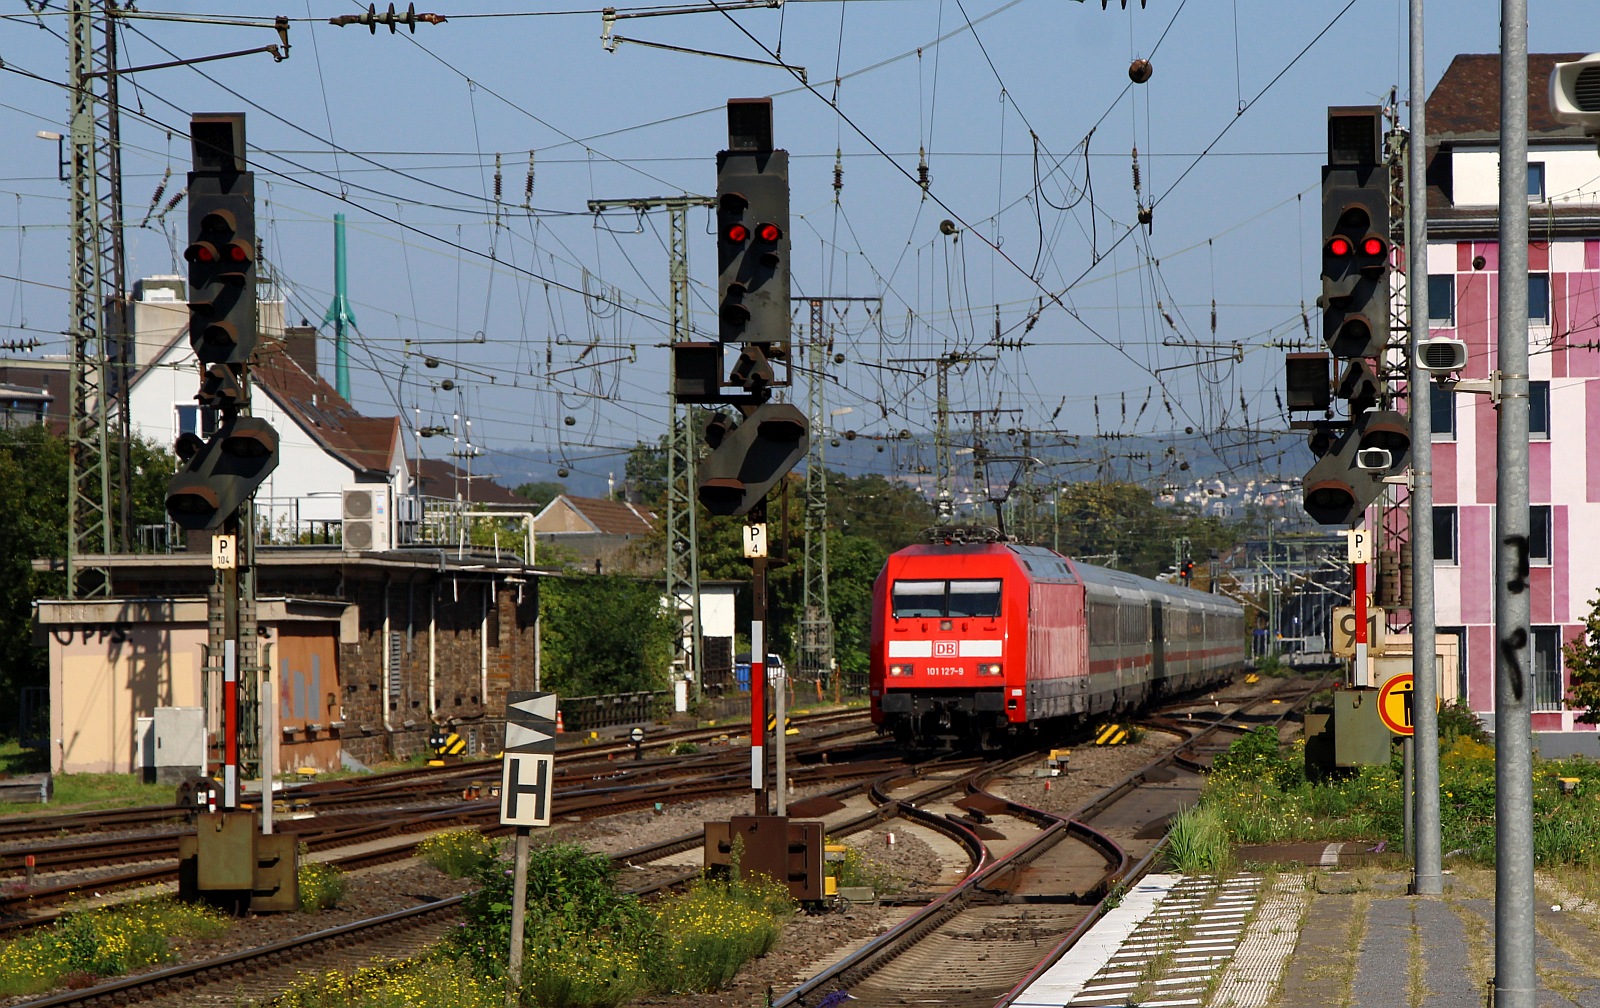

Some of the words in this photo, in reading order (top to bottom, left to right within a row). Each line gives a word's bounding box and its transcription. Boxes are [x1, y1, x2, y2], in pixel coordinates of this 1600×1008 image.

[751, 527, 760, 541] P
[220, 540, 228, 553] P
[1355, 534, 1363, 548] P
[752, 544, 758, 554] 4
[1357, 550, 1362, 559] 3
[218, 556, 230, 564] 104
[1340, 613, 1377, 648] 91
[937, 643, 954, 655] DB
[927, 667, 939, 676] 101
[941, 667, 964, 676] 127-9
[506, 758, 548, 820] H
